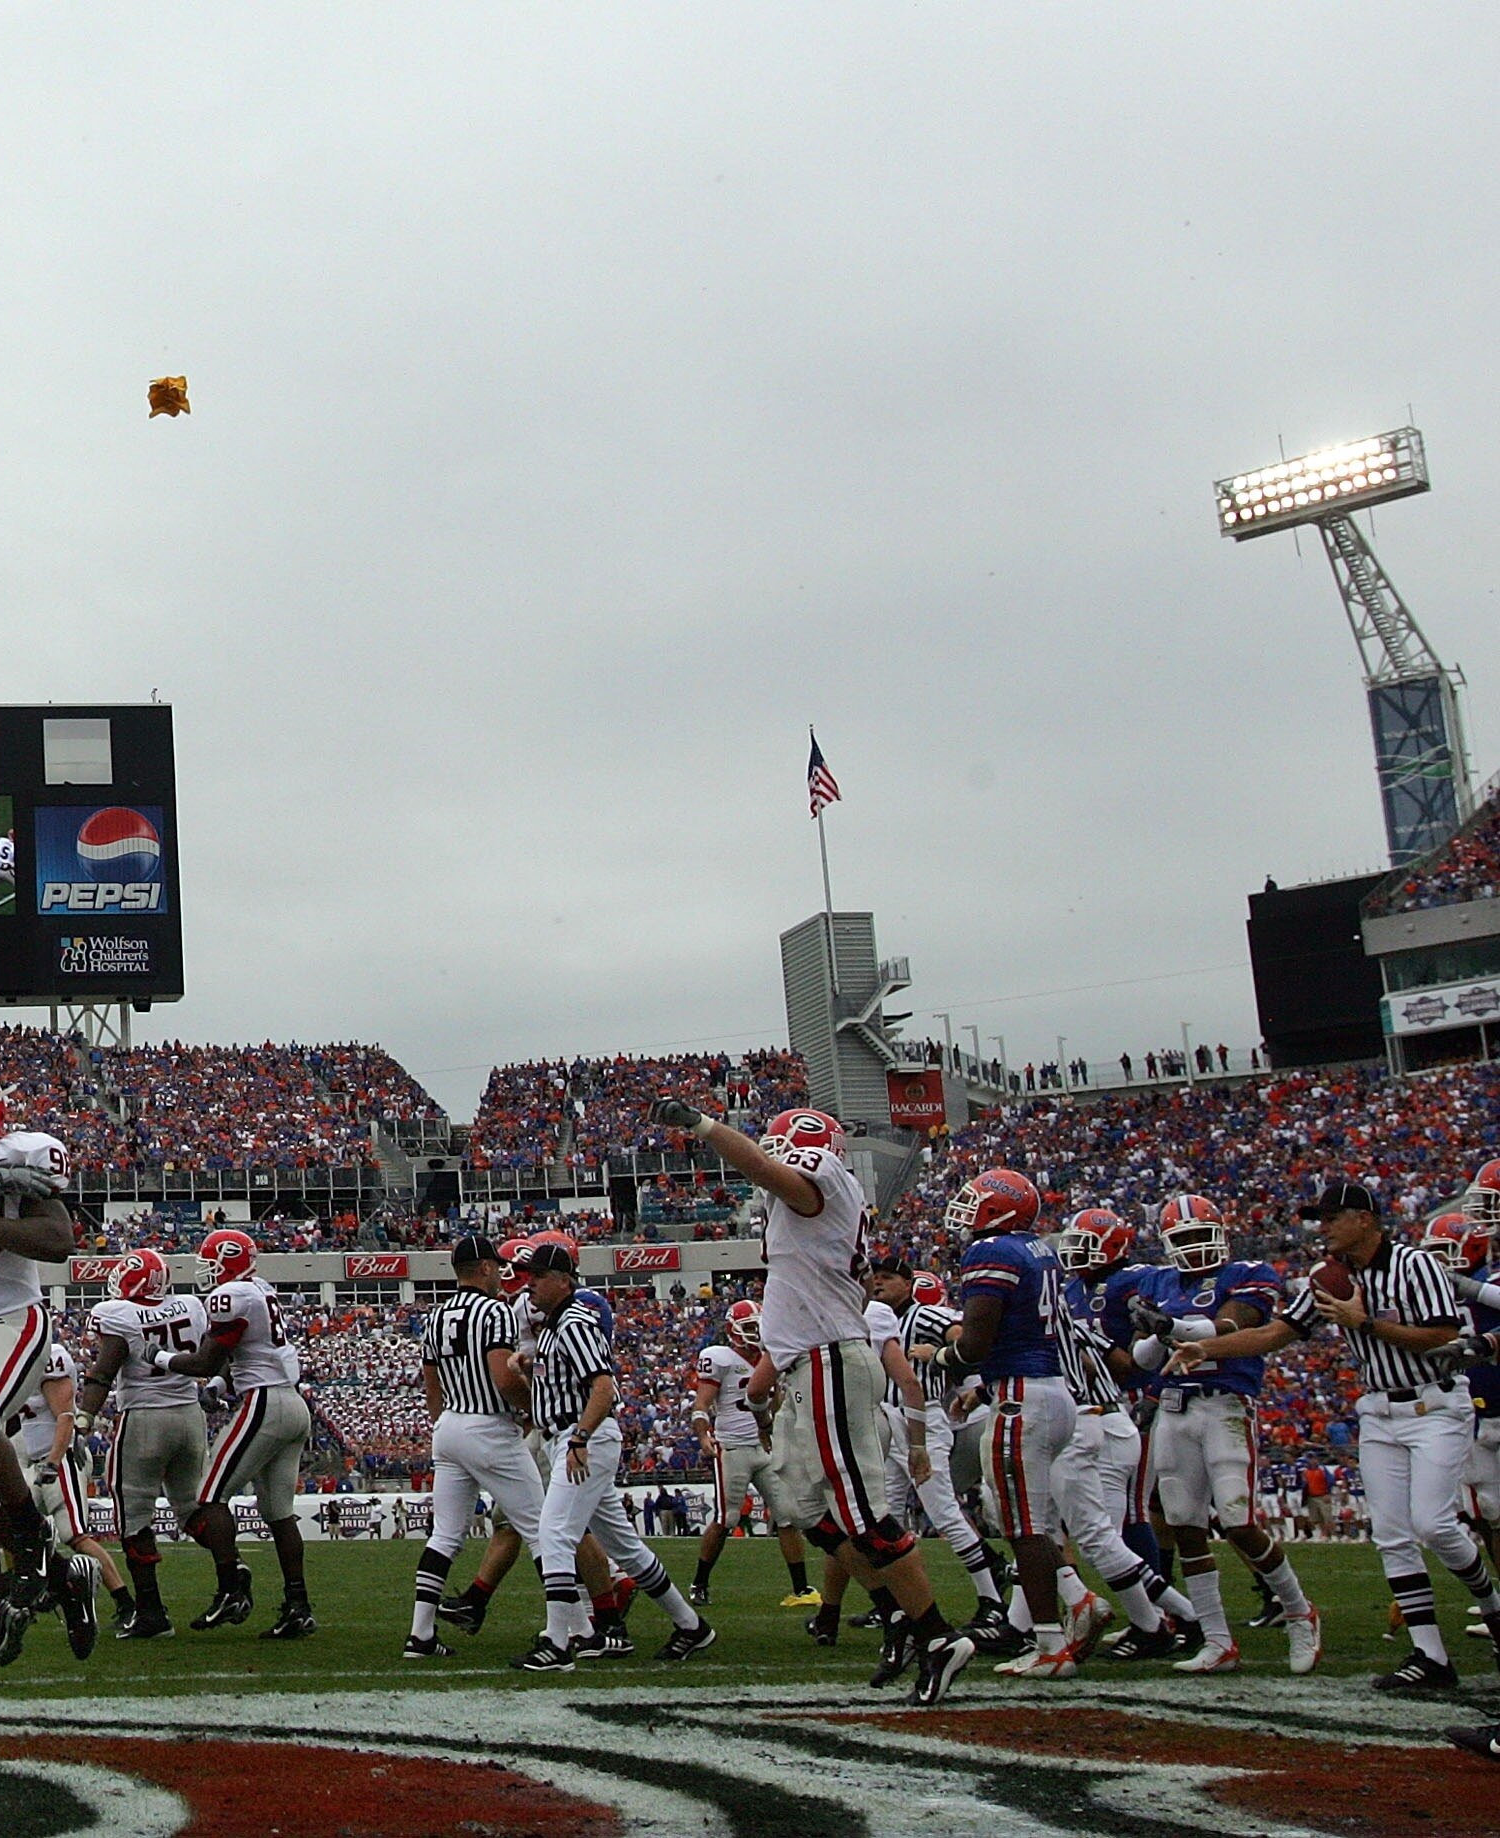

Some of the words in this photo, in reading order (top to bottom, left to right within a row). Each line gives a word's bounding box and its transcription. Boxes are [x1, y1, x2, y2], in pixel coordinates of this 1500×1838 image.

[41, 882, 161, 909] PEPSI
[89, 936, 149, 950] Wolfson
[89, 949, 149, 962] Children's
[890, 1103, 943, 1113] BACARDI
[351, 1256, 400, 1276] Bud
[619, 1247, 671, 1269] Bud
[136, 1301, 188, 1325] VELASCO
[209, 1294, 231, 1314] 89
[442, 1308, 466, 1356] F
